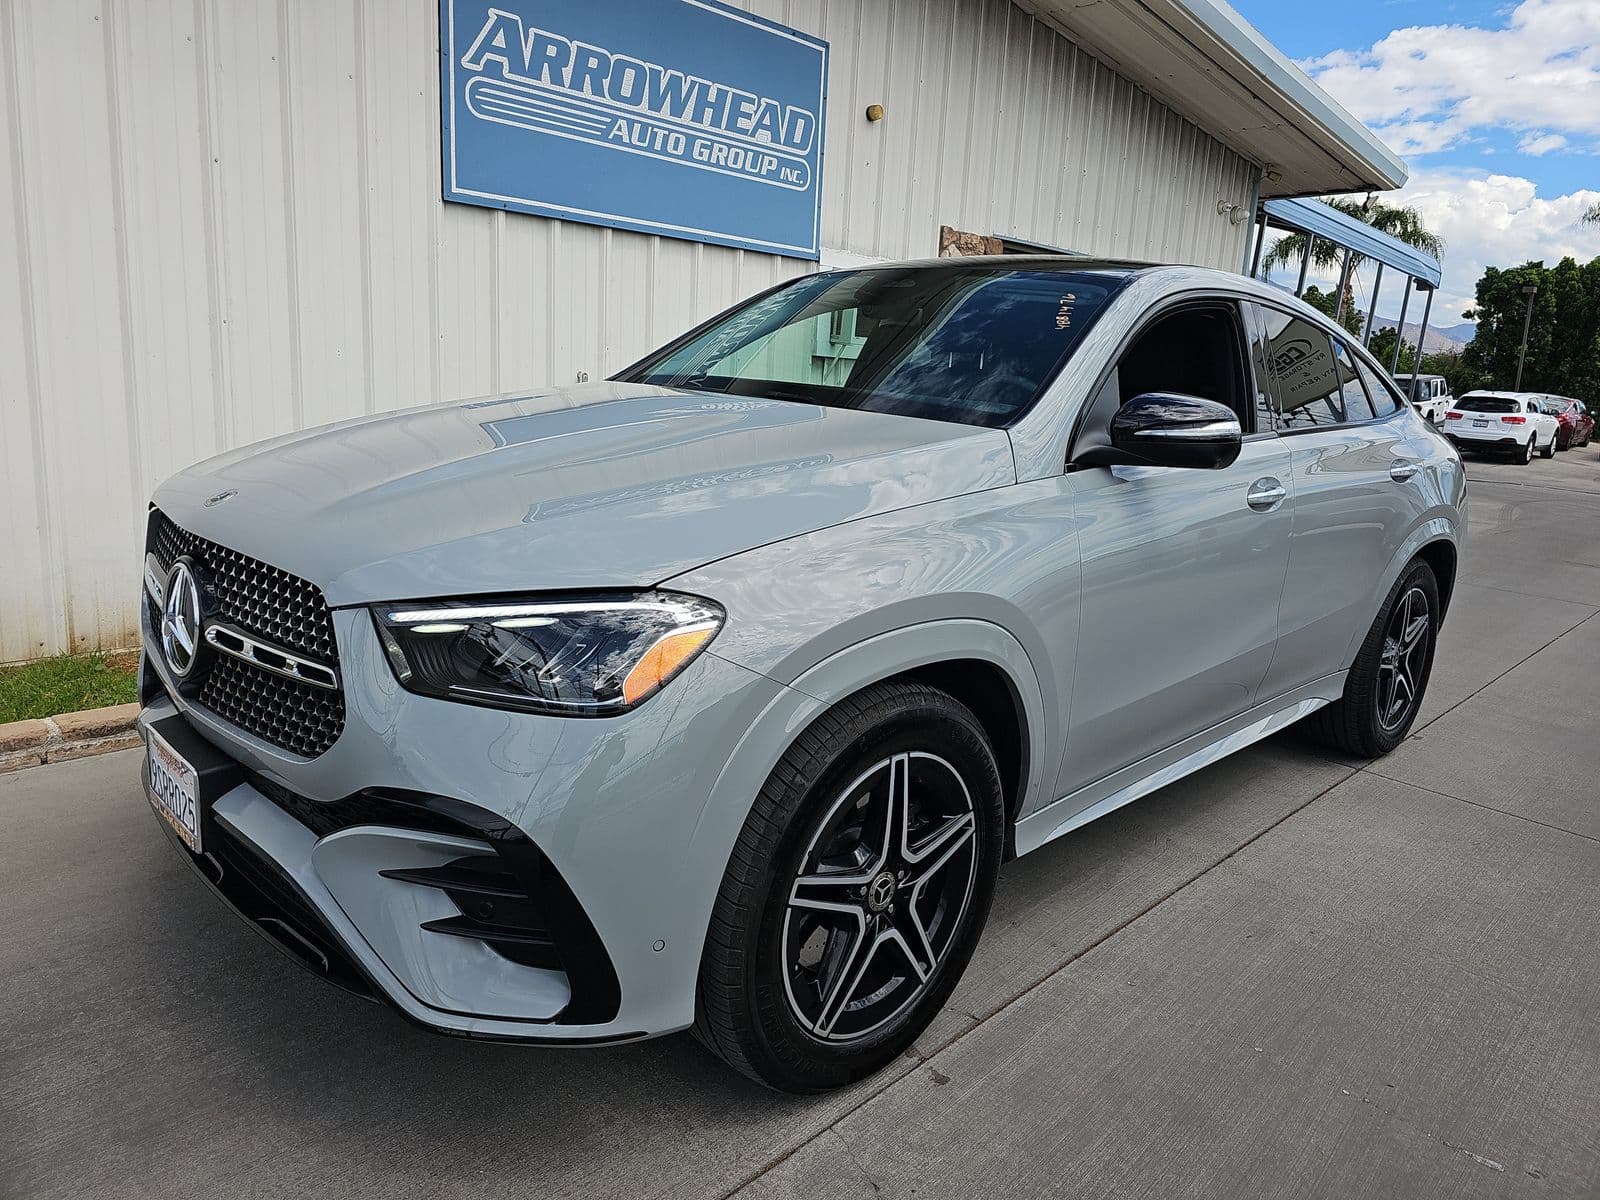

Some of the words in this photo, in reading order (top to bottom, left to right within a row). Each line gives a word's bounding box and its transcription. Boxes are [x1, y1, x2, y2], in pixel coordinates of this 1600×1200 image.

[461, 8, 815, 155] ARROWHEAD
[607, 118, 686, 156] AUTO
[693, 140, 778, 176] GROUP
[780, 168, 804, 184] INC.
